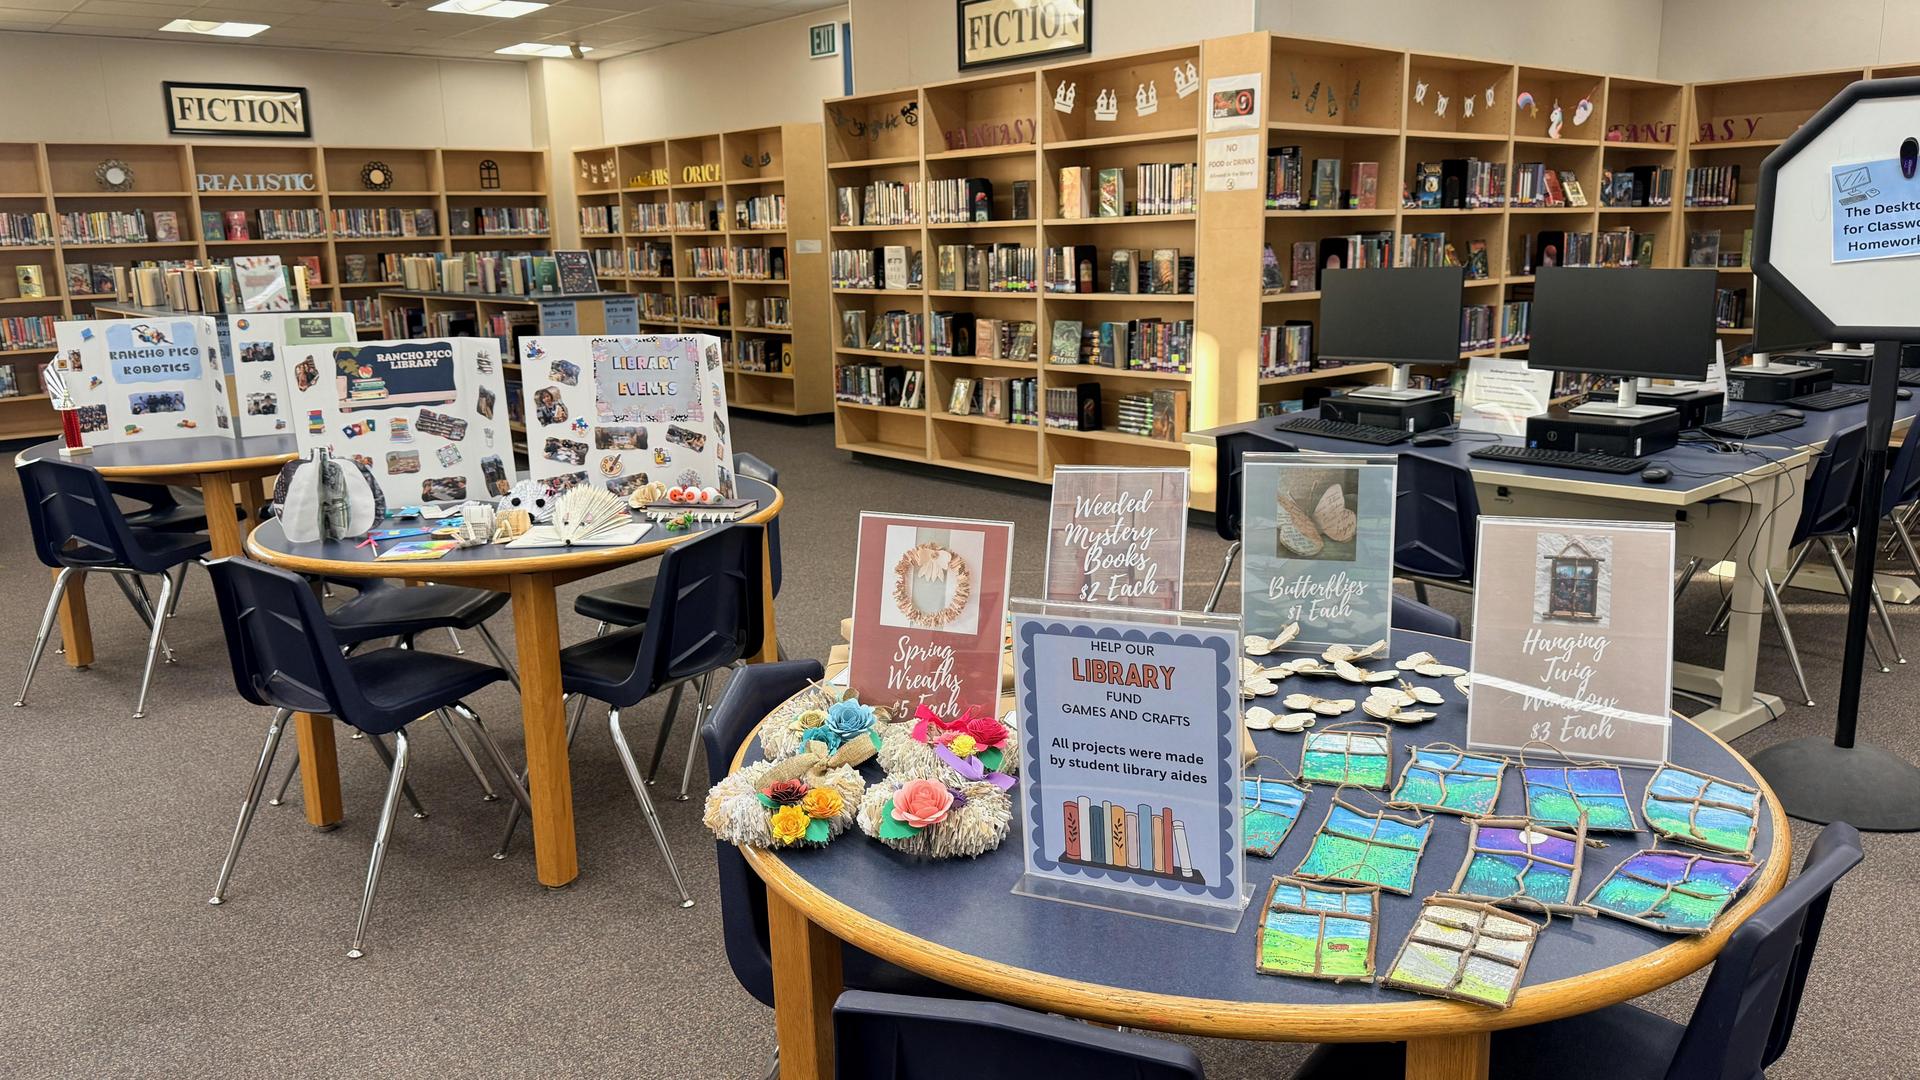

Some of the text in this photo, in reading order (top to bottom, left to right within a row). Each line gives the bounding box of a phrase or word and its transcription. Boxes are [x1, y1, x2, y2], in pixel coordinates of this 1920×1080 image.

[968, 2, 1080, 50] FICTION
[813, 26, 834, 54] EXIT
[176, 96, 299, 124] FICTION
[1226, 144, 1238, 152] NO
[1208, 160, 1225, 168] FOOD
[1233, 158, 1255, 167] DRINKS
[197, 173, 315, 191] REALISTIC
[1845, 206, 1871, 218] The
[1843, 224, 1864, 235] for
[109, 347, 199, 360] RANCHO PICO
[376, 349, 452, 362] RANCHO PICO
[391, 359, 439, 369] LIBRARY
[613, 355, 679, 370] LIBRARY
[123, 363, 190, 375] ROBOTICS
[618, 382, 678, 396] EVENTS
[1075, 488, 1154, 518] Weeded
[1065, 517, 1158, 550] Mystery
[1084, 545, 1151, 575] Books
[1080, 563, 1158, 602] $2 Each
[1269, 571, 1368, 600] Butterflies
[1288, 596, 1352, 622] $1 Each
[894, 635, 956, 669] Spring
[1091, 641, 1154, 656] HELP OUR
[1522, 628, 1612, 662] Hanging
[888, 658, 963, 691] Wreaths
[1072, 657, 1176, 690] LIBRARY
[1540, 656, 1597, 692] Twig
[1106, 691, 1142, 704] FUND
[1523, 687, 1619, 712] Widow
[1061, 703, 1191, 727] GAMES AND CRAFTS
[1531, 714, 1615, 742] $3 Each
[1051, 737, 1204, 765] All projects were made
[1050, 754, 1208, 784] by student library aides
